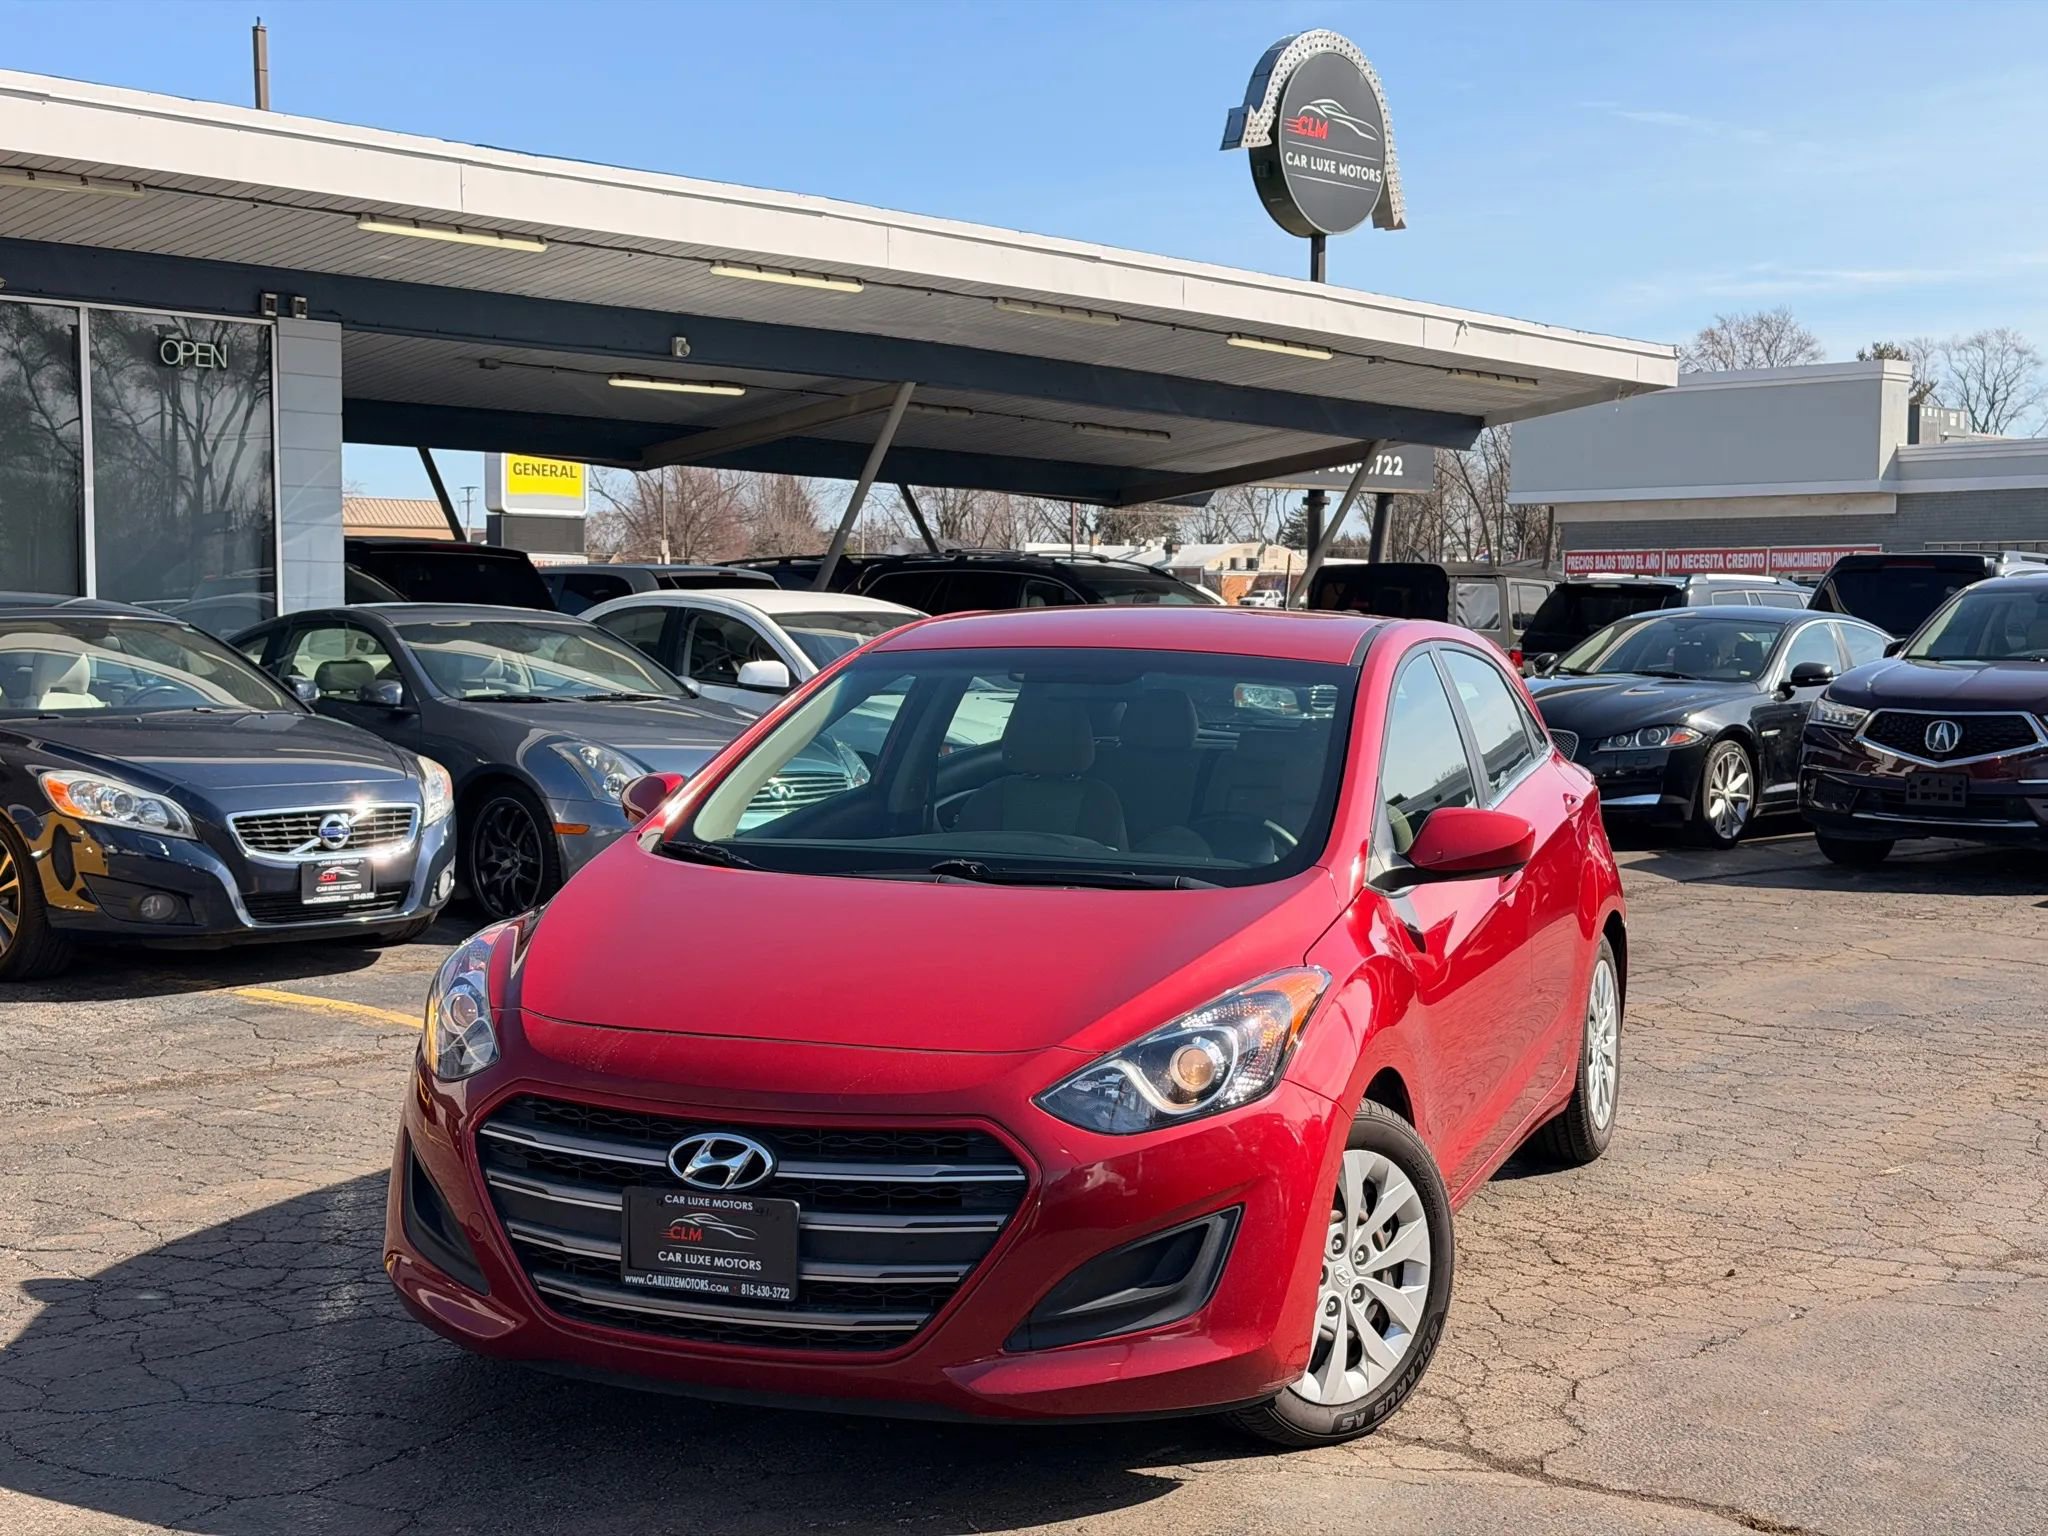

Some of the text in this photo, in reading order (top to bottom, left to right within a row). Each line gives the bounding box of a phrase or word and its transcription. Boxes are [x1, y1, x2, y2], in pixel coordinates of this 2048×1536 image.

[1296, 115, 1329, 140] CLM
[1285, 152, 1382, 183] CAR LUXE MOTORS
[160, 340, 227, 368] OPEN
[513, 461, 578, 479] GENERAL
[1566, 555, 1594, 570] PRECIOS
[1595, 555, 1616, 570] BAJOS
[1617, 555, 1635, 569] TODO
[1636, 555, 1644, 569] EL
[1667, 552, 1765, 569] NO NECESITA CREDITO
[1771, 551, 1832, 568] FINANCIAMIENTO
[664, 1194, 754, 1211] CAR LUXE MOTORS
[669, 1225, 703, 1241] CLM
[657, 1251, 762, 1271] CAR LUXE MOTORS
[740, 1283, 790, 1300] 815-630-3722
[1338, 1412, 1366, 1432] AS
